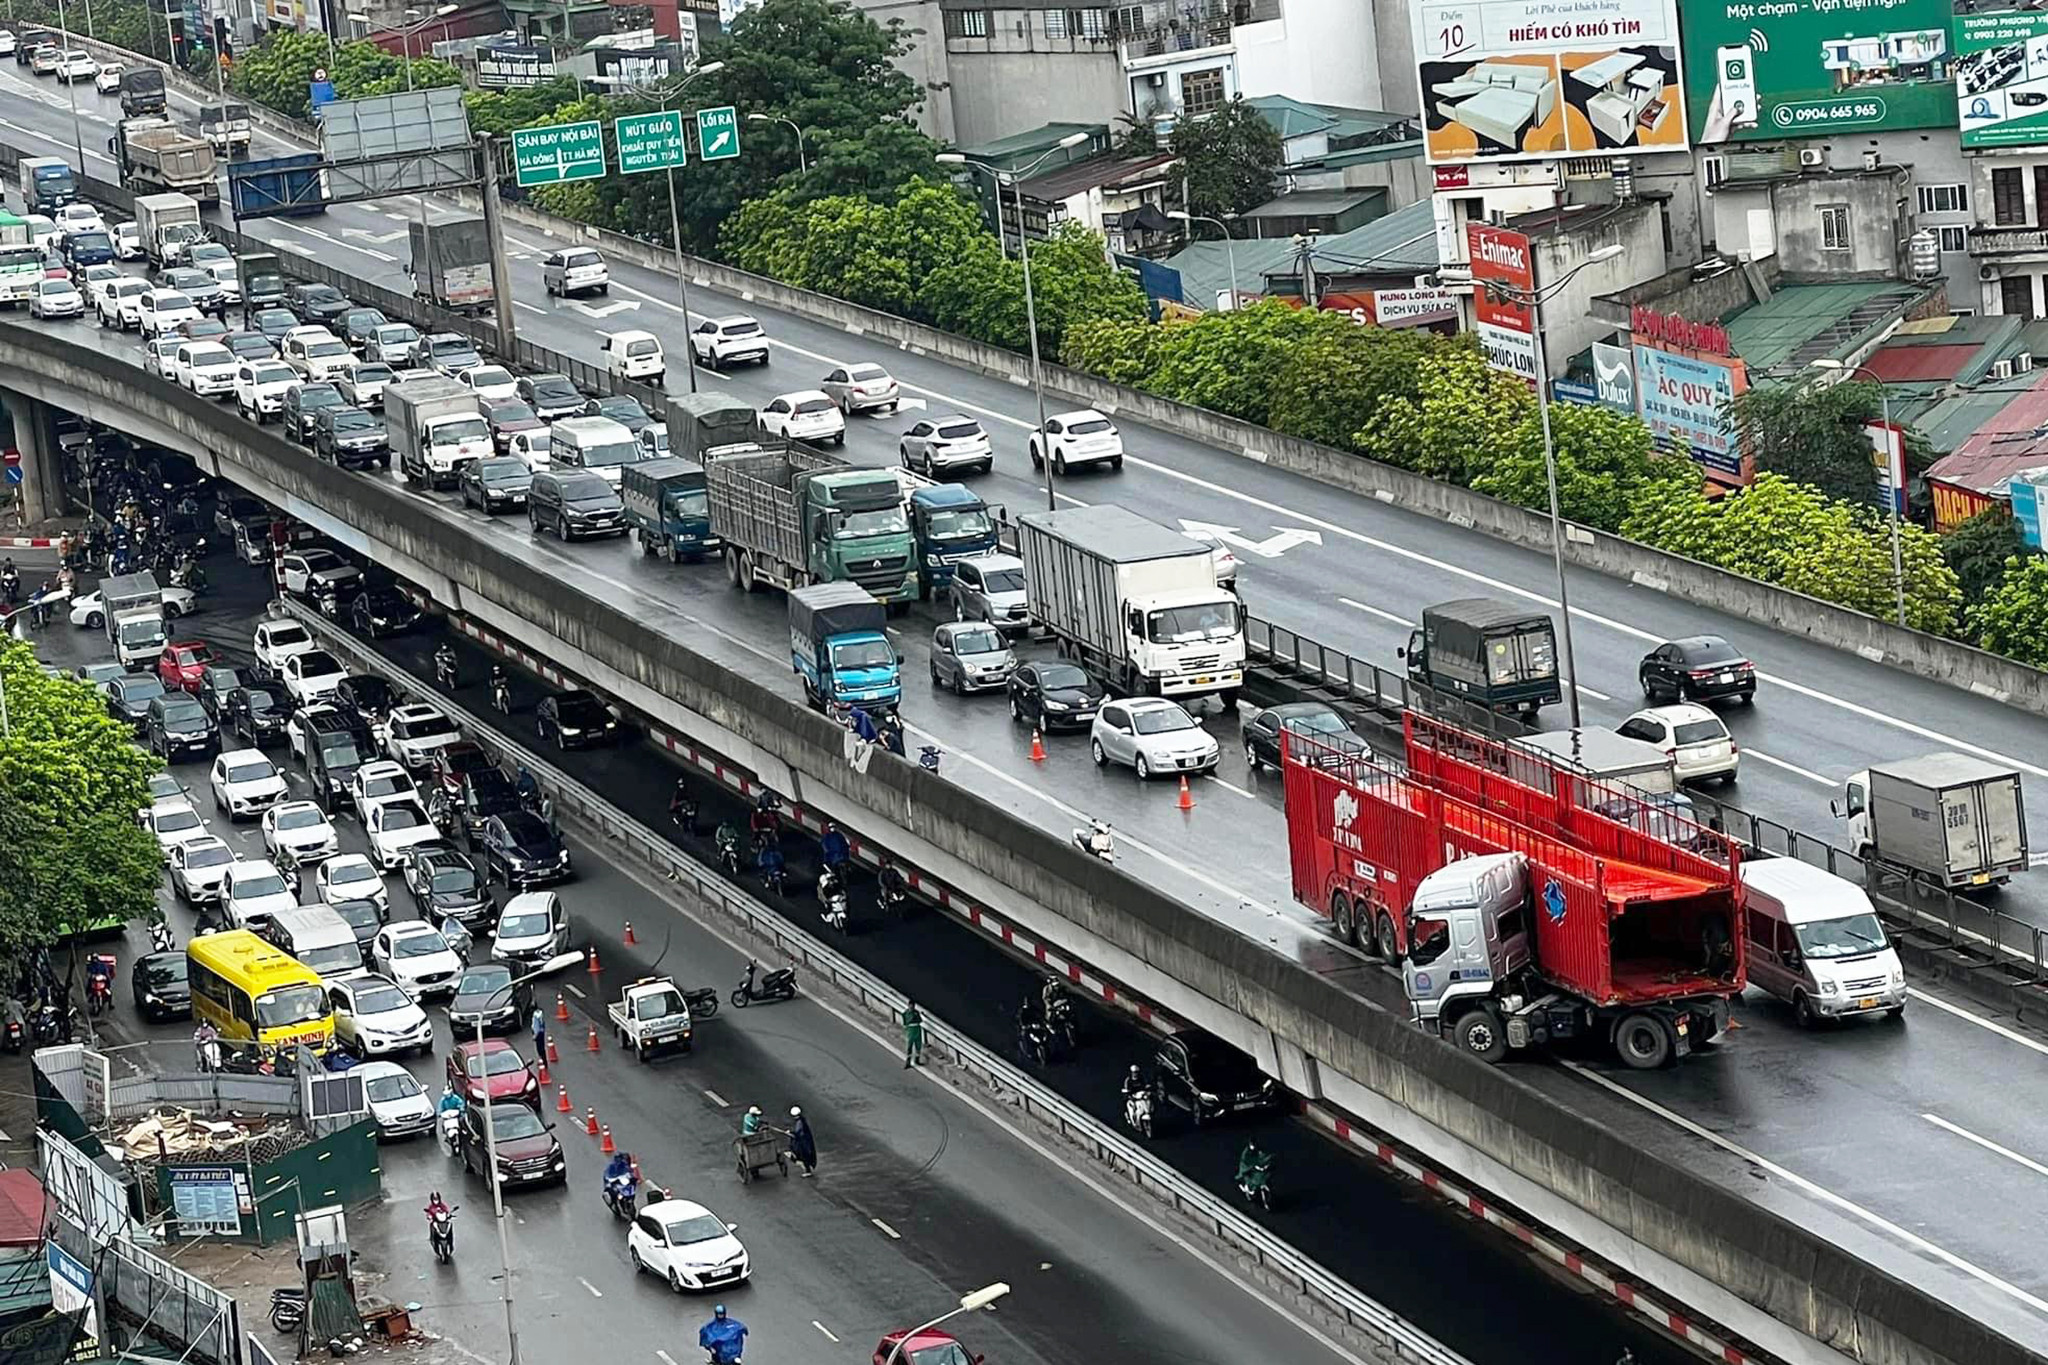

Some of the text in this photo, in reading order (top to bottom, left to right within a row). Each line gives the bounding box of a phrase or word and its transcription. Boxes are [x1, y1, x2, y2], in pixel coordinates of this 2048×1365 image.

[1726, 4, 1754, 21] Một
[1757, 2, 1798, 18] chạm
[1440, 24, 1464, 51] 10
[1509, 17, 1641, 42] HIẾM CÓ KHÓ TÌM
[718, 114, 733, 126] RA
[1796, 104, 1877, 121] 0904 665 965
[625, 122, 646, 137] NÚT
[540, 132, 559, 145] BAY
[1480, 233, 1525, 269] Enimac
[1383, 305, 1406, 316] DỊCH
[299, 1030, 325, 1043] MINH
